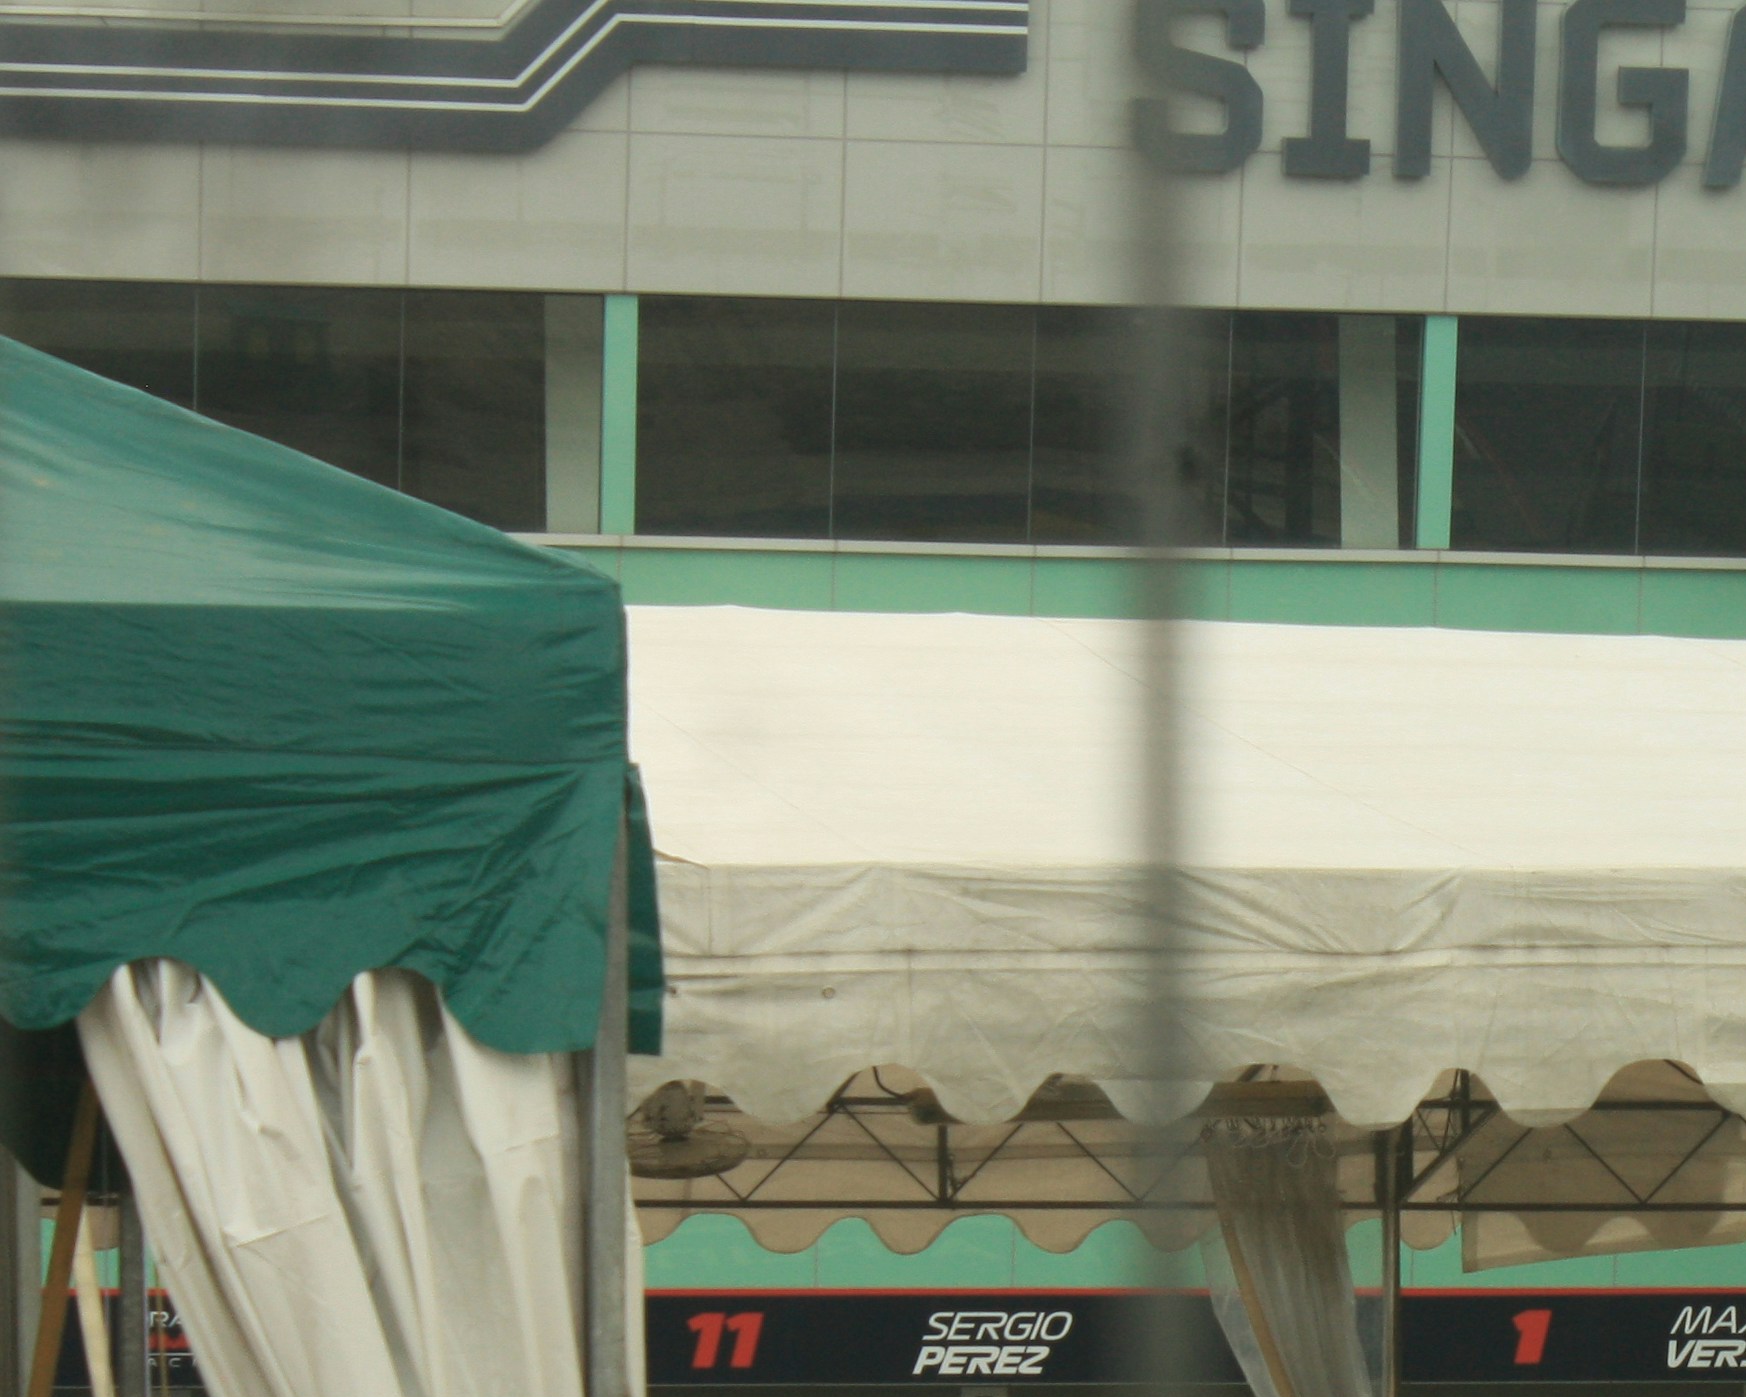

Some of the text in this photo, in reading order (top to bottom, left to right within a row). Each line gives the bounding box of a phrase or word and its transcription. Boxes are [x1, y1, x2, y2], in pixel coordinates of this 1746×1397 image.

[687, 1312, 764, 1368] 11
[922, 1310, 1073, 1342] SERGIO
[1511, 1310, 1552, 1365] 1
[912, 1345, 1051, 1376] PEREZ
